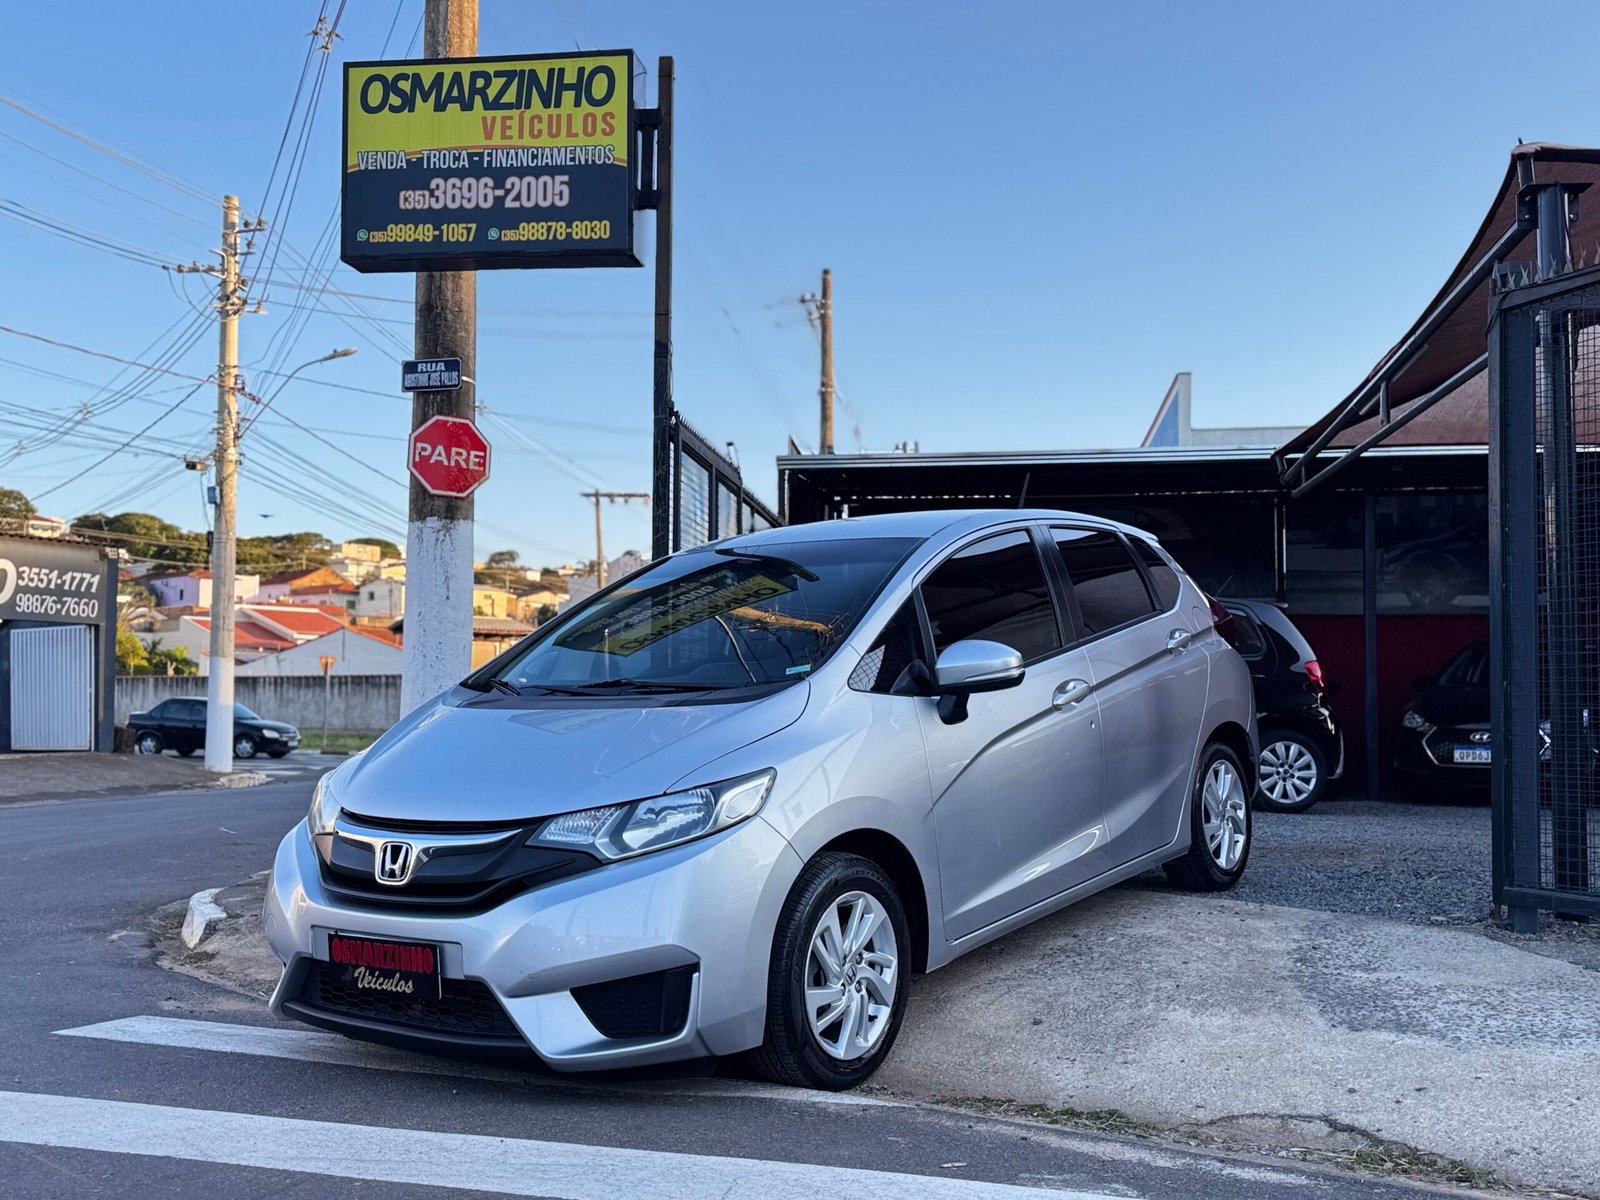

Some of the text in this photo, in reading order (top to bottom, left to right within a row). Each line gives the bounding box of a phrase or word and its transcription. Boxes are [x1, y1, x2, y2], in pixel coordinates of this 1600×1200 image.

[360, 66, 616, 114] OSMARZINHO
[481, 110, 616, 141] VEÍCULOS
[357, 151, 407, 170] VENDA
[422, 150, 469, 170] TROCA
[483, 145, 615, 168] FINANCIAMENTOS
[417, 362, 445, 372] RUA
[414, 442, 485, 471] PARE
[332, 938, 433, 974] OSMARZINHO
